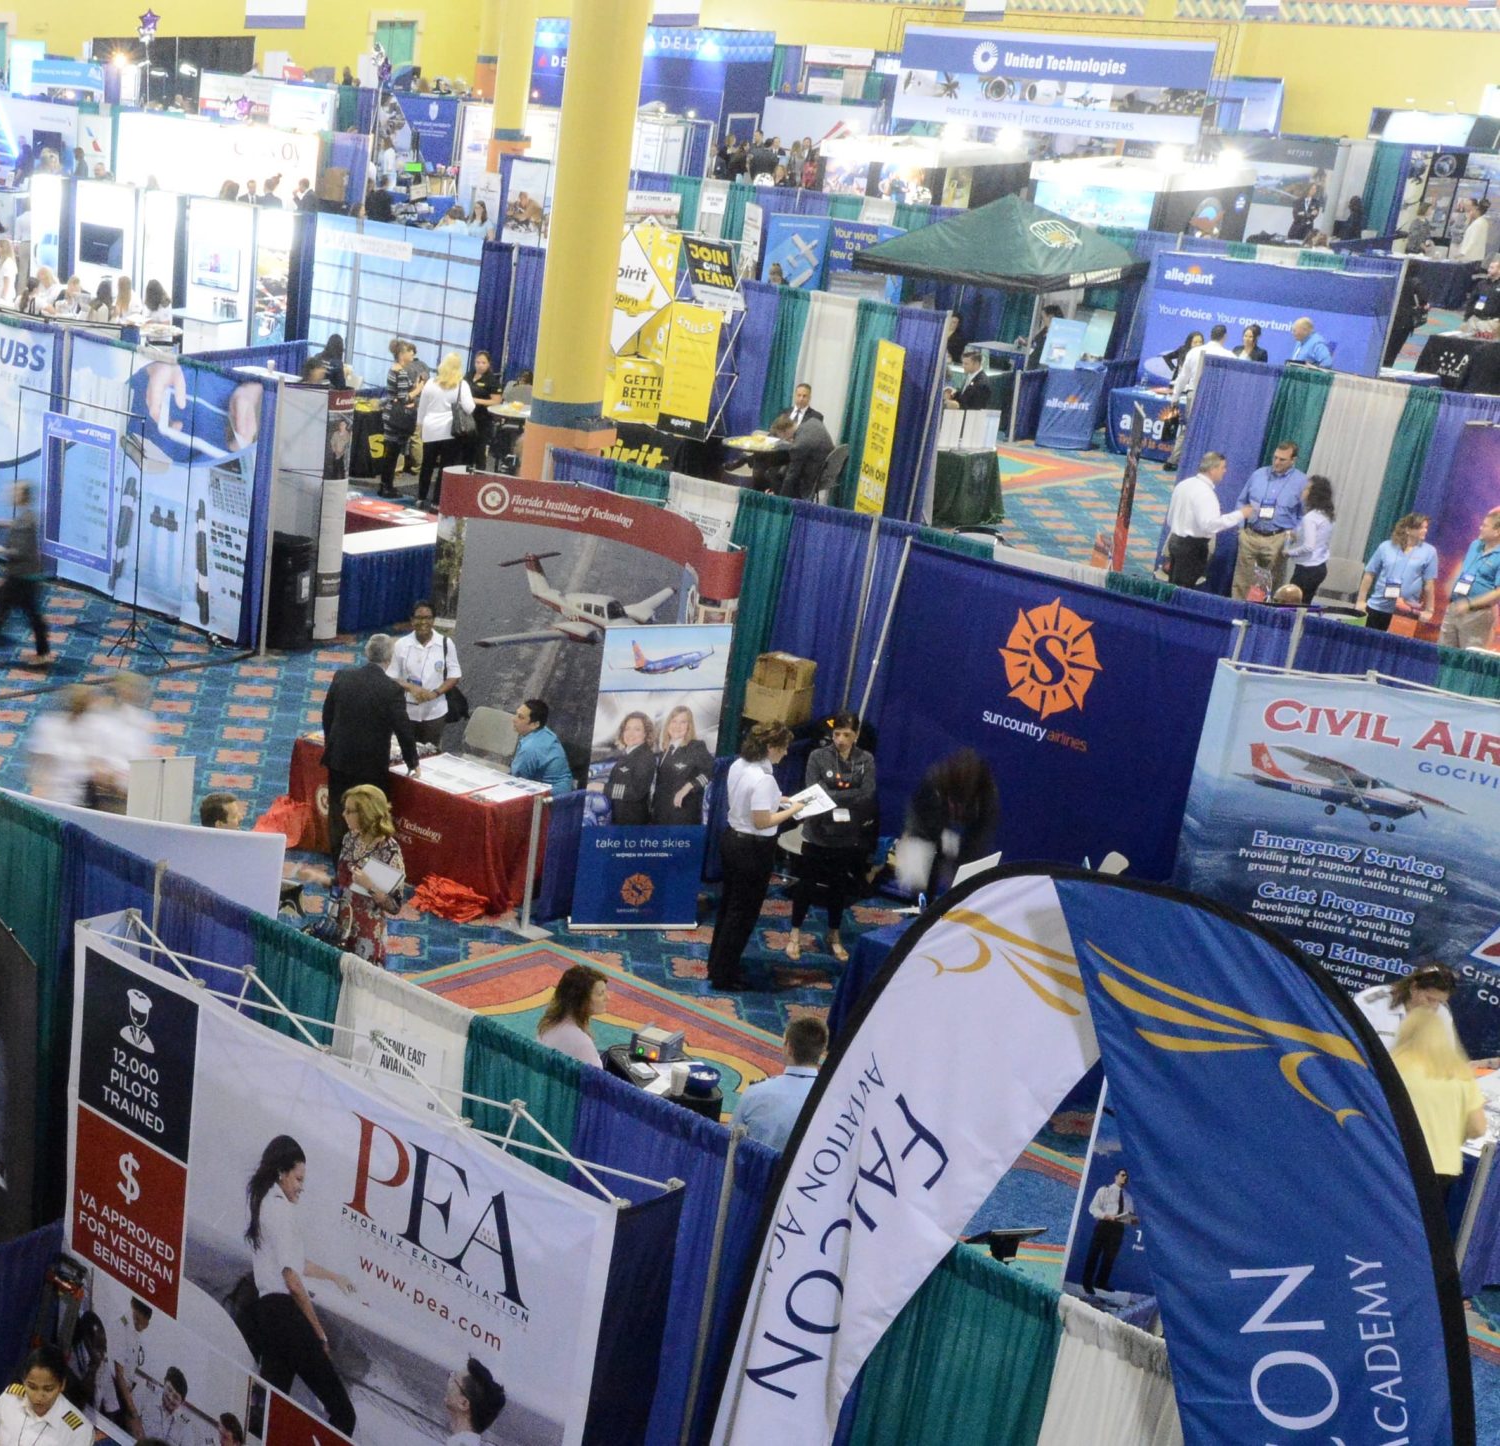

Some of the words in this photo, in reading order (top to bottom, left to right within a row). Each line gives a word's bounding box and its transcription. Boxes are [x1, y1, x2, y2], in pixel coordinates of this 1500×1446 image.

[660, 35, 706, 51] DELT
[1004, 51, 1043, 70] United
[1046, 54, 1127, 76] Technologies
[946, 107, 971, 118] PRATT
[981, 110, 1018, 122] WHITNEY
[1025, 113, 1041, 125] UTC
[1043, 115, 1092, 129] AEROSPACE
[1094, 118, 1135, 132] SYSTEMS
[834, 226, 852, 239] Your
[854, 231, 878, 243] wings
[845, 240, 854, 250] to
[688, 243, 730, 267] JOIN
[829, 249, 847, 260] new
[694, 269, 735, 288] TEAM!
[1164, 267, 1215, 286] allegiant
[1158, 304, 1179, 316] Your
[1216, 312, 1238, 324] Your
[1239, 316, 1294, 332] opportuni
[622, 386, 662, 400] BETTE
[624, 374, 663, 388] GETTI
[636, 400, 651, 409] THE
[670, 418, 692, 429] spirit
[511, 493, 544, 509] Florida
[545, 498, 581, 515] Institute
[581, 506, 593, 519] of
[592, 506, 635, 529] Technology
[1263, 698, 1401, 748] CIVIL
[1047, 730, 1088, 752] airlines
[595, 837, 621, 849] take
[624, 838, 637, 849] to
[640, 837, 659, 849] the
[662, 837, 691, 849] skies
[1252, 830, 1361, 862] Emergency
[1364, 847, 1445, 880] Services
[1238, 848, 1289, 864] Providing
[1292, 853, 1315, 866] vital
[1318, 859, 1360, 875] support
[1363, 867, 1387, 880] with
[1390, 873, 1429, 890] trained
[1430, 883, 1449, 896] air,
[1247, 861, 1287, 875] ground
[1289, 865, 1310, 877] and
[1312, 869, 1400, 895] communications
[1402, 888, 1434, 903] teams
[1251, 899, 1310, 918] Developing
[1313, 909, 1353, 924] today's
[1355, 917, 1386, 932] youth
[1389, 924, 1411, 938] into
[1258, 881, 1318, 905] Cadet
[1320, 890, 1415, 925] Programs
[1306, 919, 1346, 935] citizens
[1349, 927, 1370, 940] and
[1371, 932, 1411, 950] leaders
[1328, 942, 1418, 977] Educatio
[1364, 970, 1386, 983] and
[112, 1046, 160, 1086] 12,000
[407, 1045, 428, 1068] EAST
[110, 1067, 160, 1109] PILOTS
[101, 1084, 166, 1134] TRAINED
[796, 1050, 886, 1203] AVIATION
[79, 1188, 98, 1214] VA
[100, 1204, 176, 1262] APPROVED
[342, 1110, 532, 1312] PEA
[79, 1209, 107, 1241] FOR
[109, 1229, 174, 1285] VETERAN
[745, 1092, 950, 1400] FALCON
[92, 1239, 157, 1296] BENEFITS
[341, 1206, 404, 1250] PHOENIX
[411, 1247, 449, 1275] EAST
[454, 1272, 531, 1324] AVIATION
[358, 1254, 502, 1352] www.pea.com
